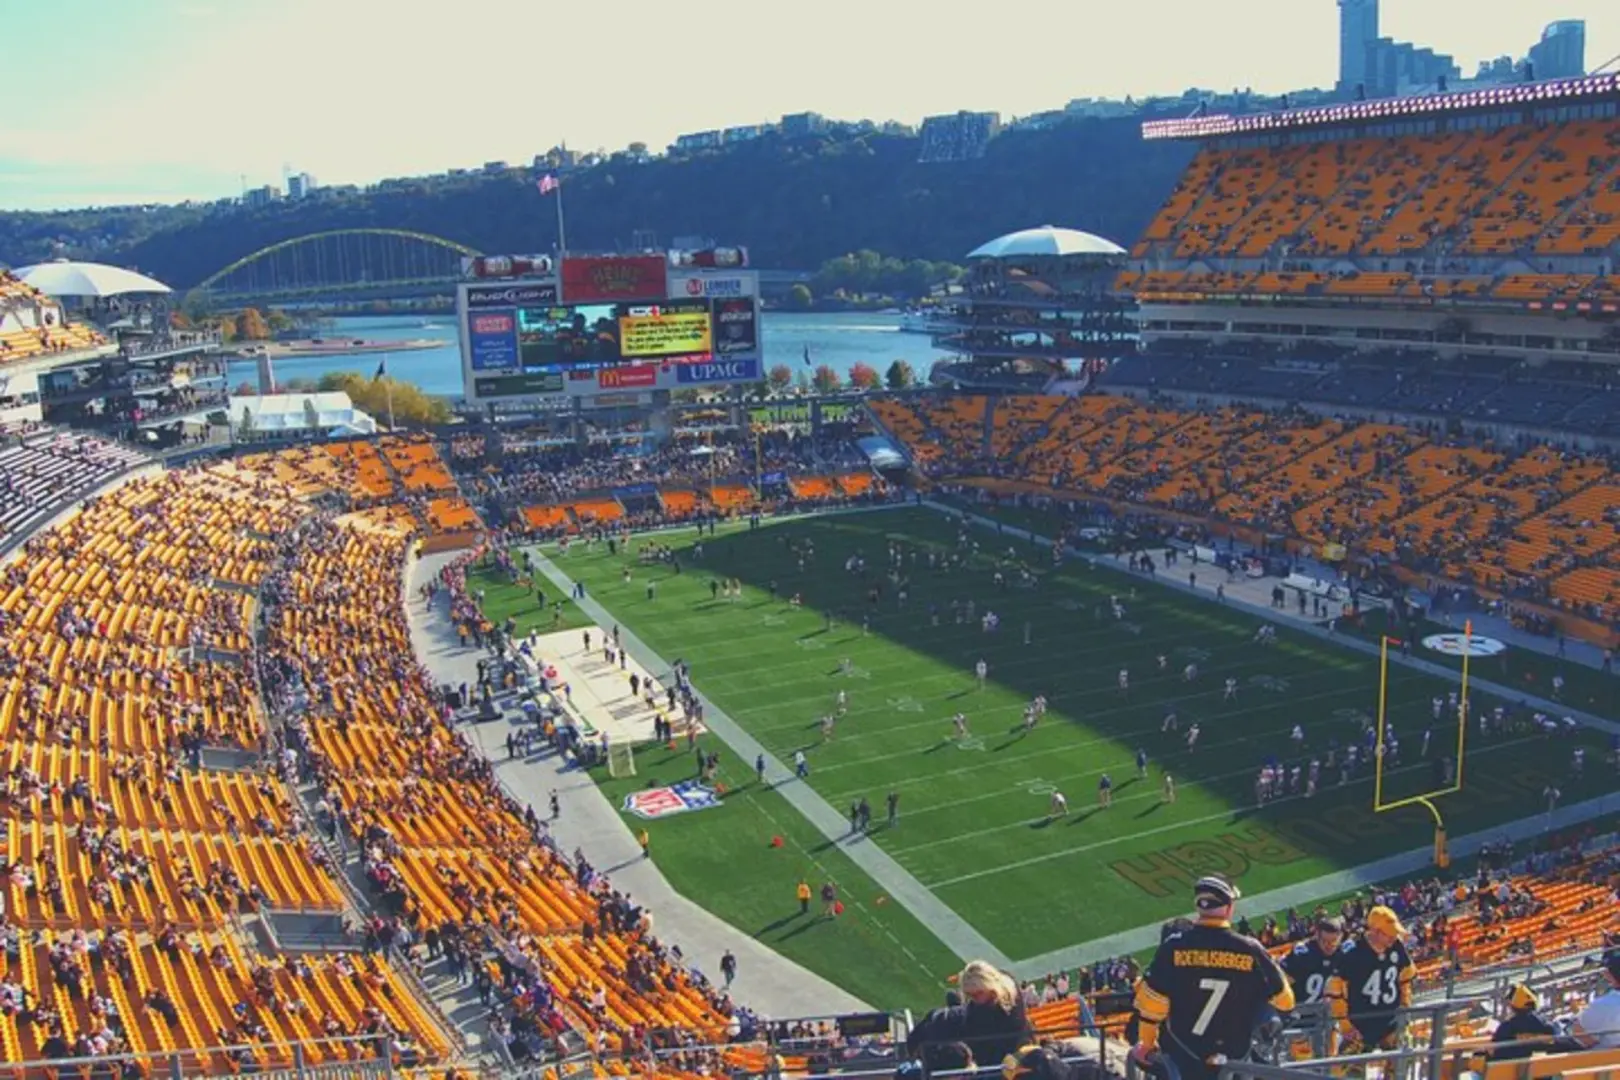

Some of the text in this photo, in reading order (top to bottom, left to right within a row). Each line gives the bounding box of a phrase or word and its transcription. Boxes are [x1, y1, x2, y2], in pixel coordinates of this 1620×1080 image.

[690, 361, 747, 380] UPMC
[1362, 966, 1397, 1005] 43
[1192, 978, 1229, 1035] 7
